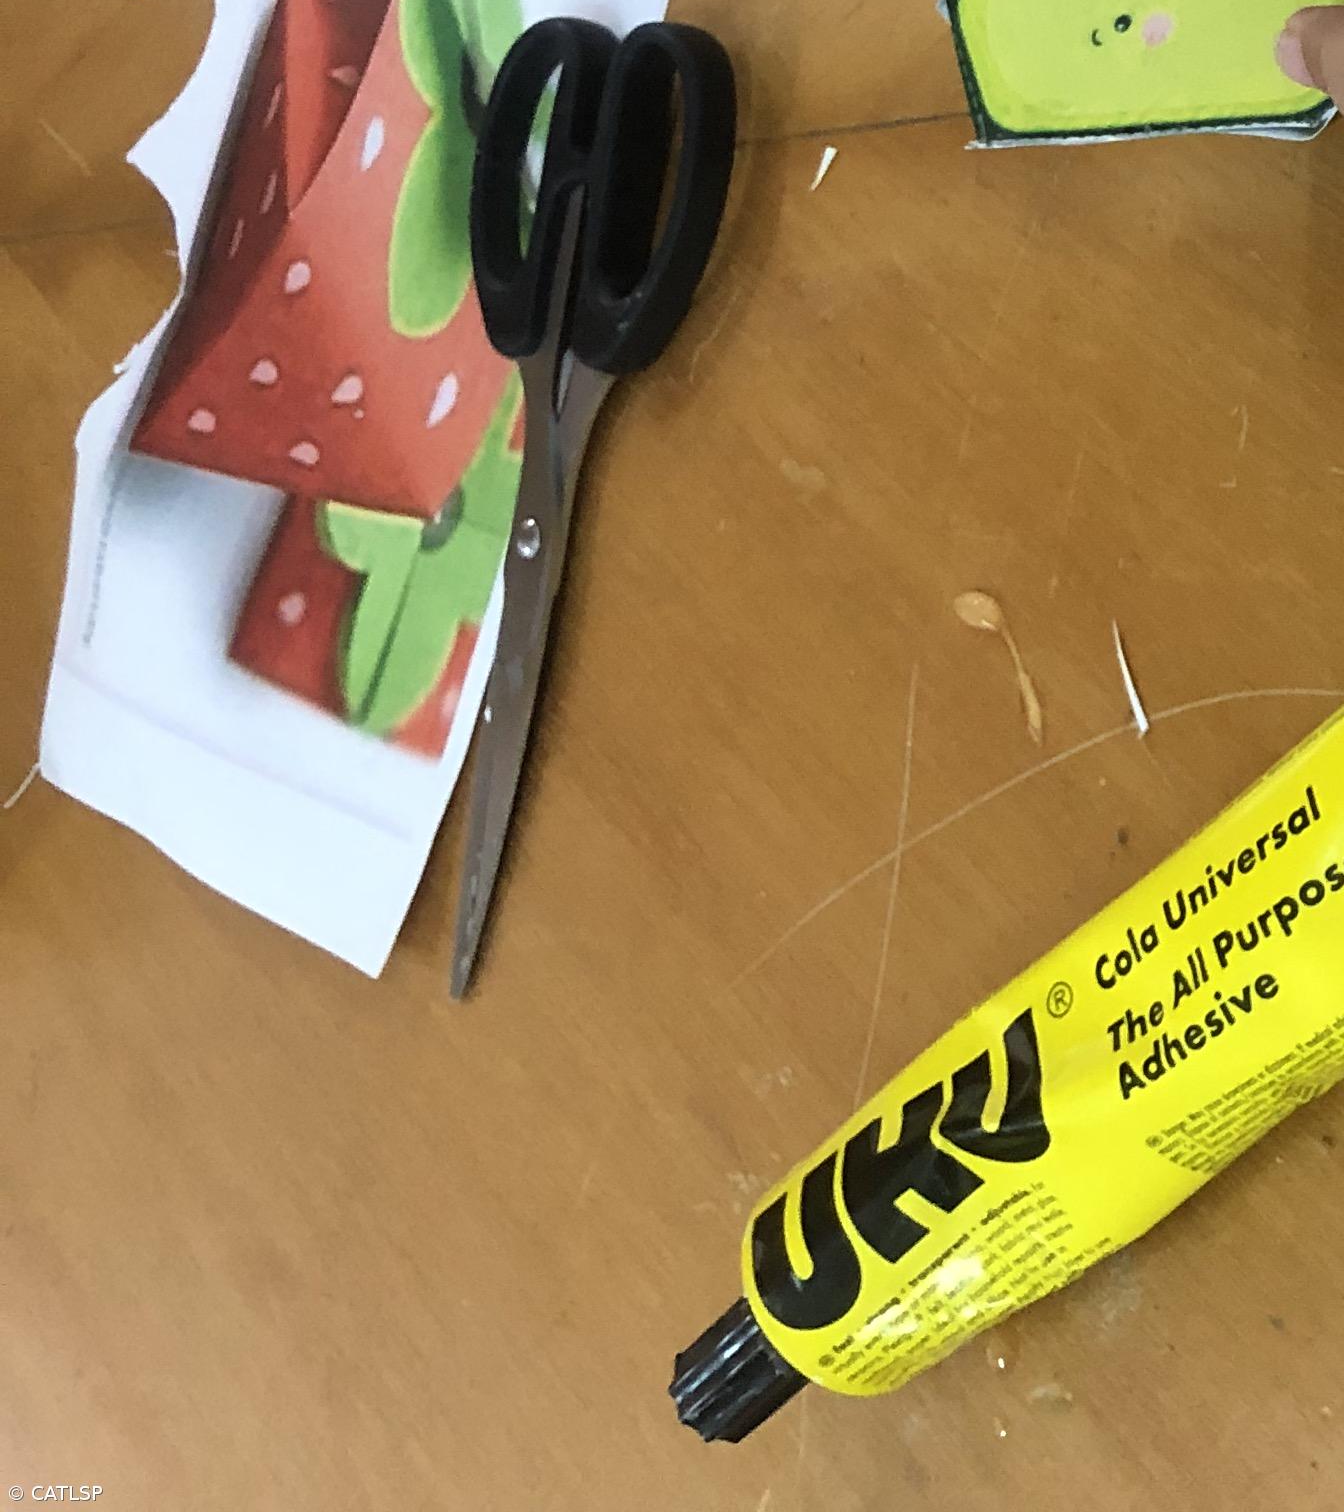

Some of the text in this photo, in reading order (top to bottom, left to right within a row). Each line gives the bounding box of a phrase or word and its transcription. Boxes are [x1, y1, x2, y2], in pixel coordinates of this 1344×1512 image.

[1095, 786, 1320, 989] Cola Universal
[1107, 1001, 1163, 1051] The
[1173, 947, 1208, 1009] All
[1118, 974, 1278, 1099] Adhesive
[751, 1007, 1050, 1330] UHU
